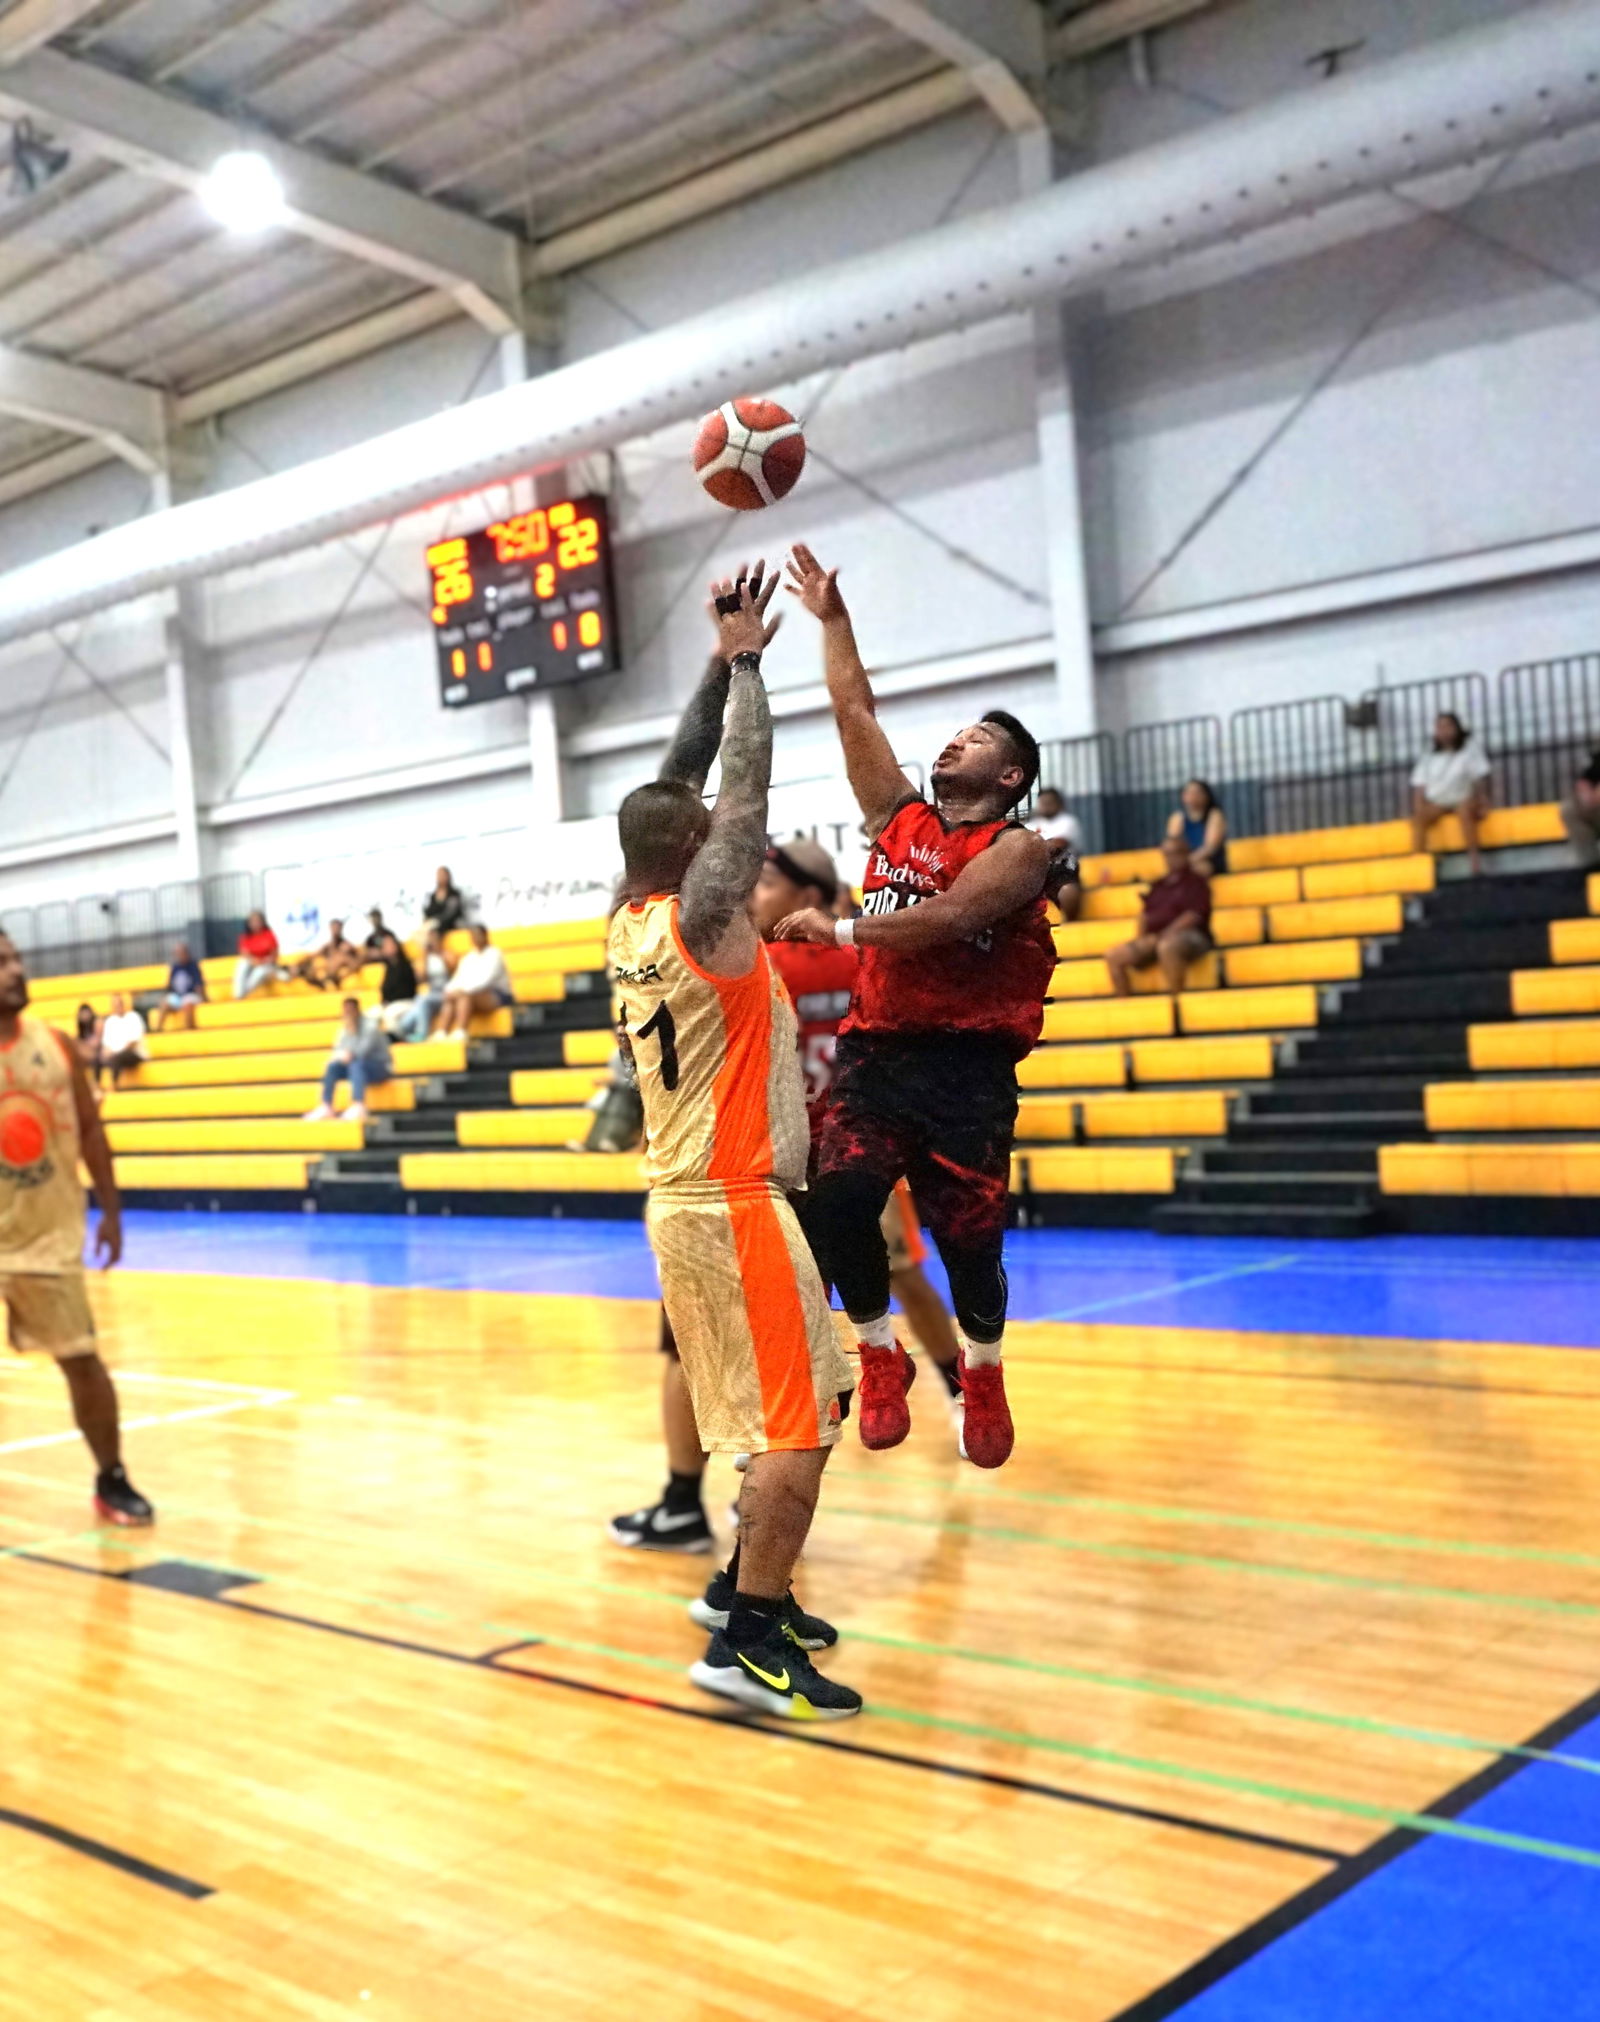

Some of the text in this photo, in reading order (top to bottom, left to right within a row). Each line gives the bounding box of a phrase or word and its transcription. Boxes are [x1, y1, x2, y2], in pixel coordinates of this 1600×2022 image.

[487, 509, 549, 562] 7:50
[557, 517, 599, 570] 22
[535, 562, 555, 598] 2
